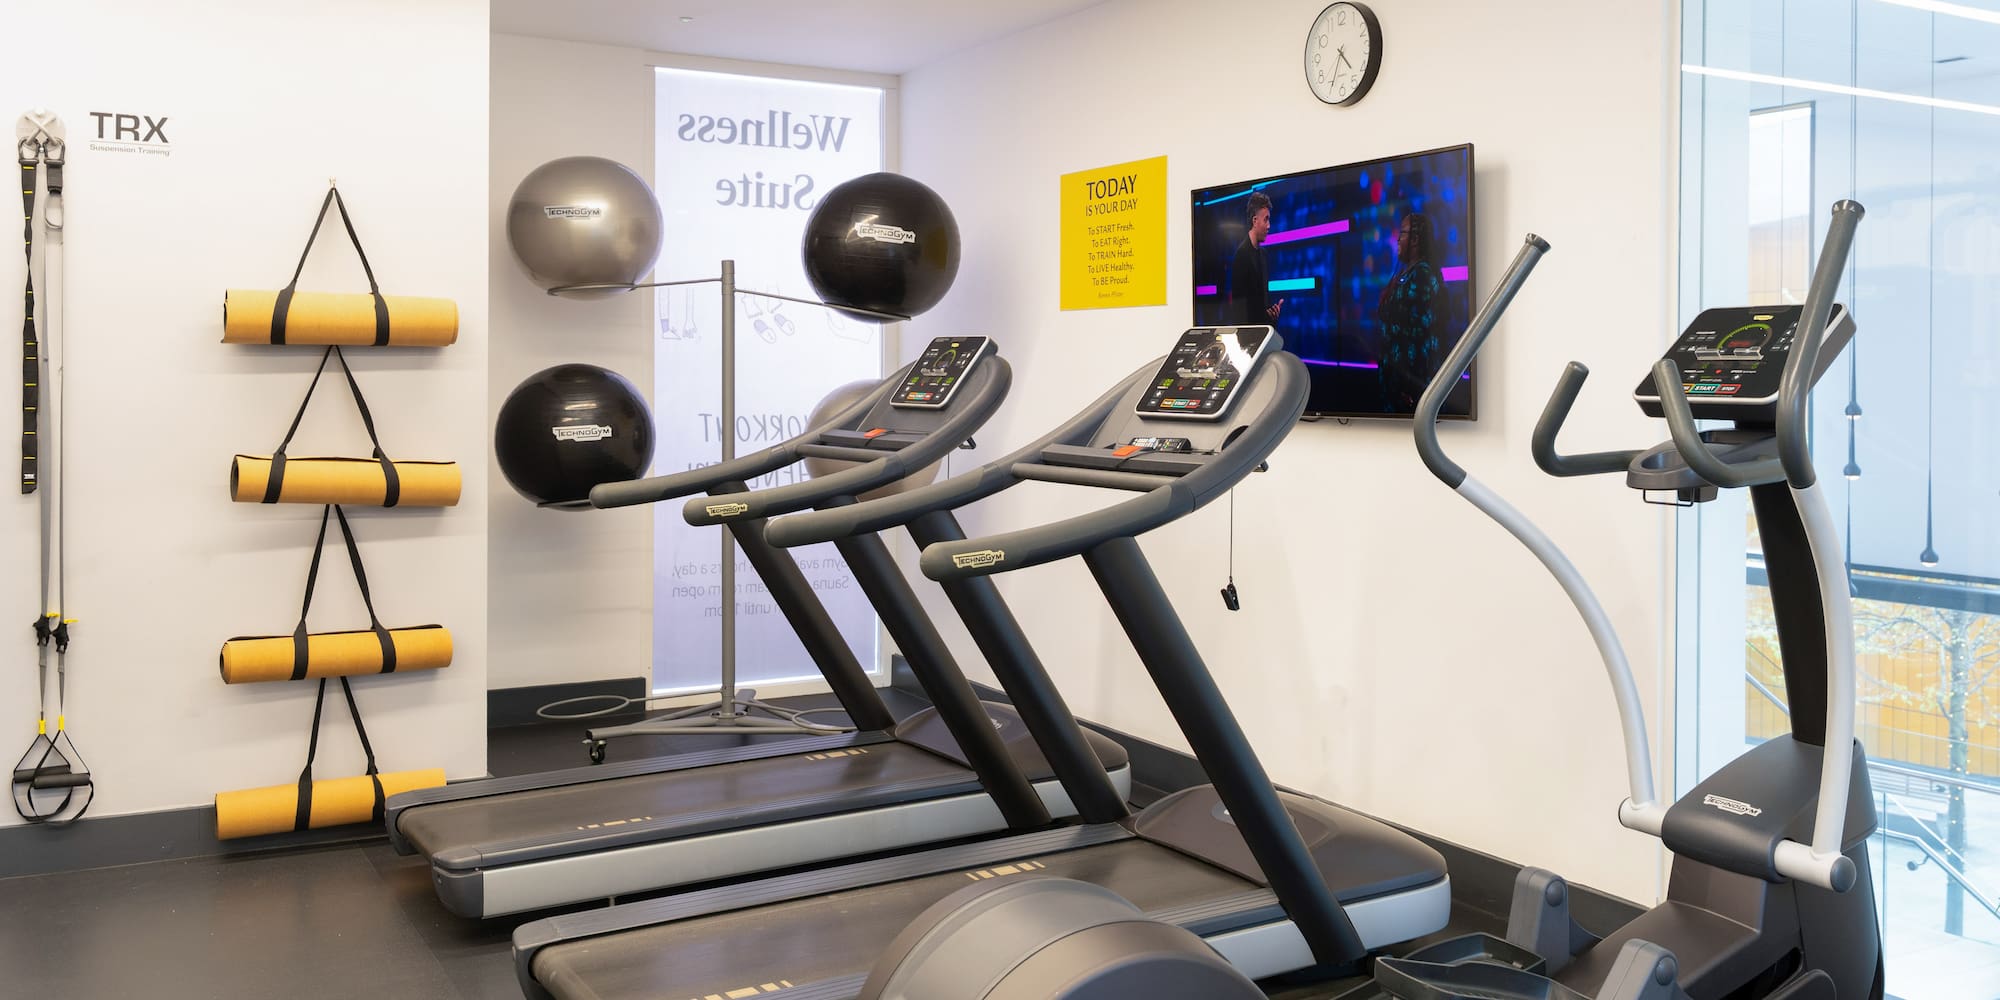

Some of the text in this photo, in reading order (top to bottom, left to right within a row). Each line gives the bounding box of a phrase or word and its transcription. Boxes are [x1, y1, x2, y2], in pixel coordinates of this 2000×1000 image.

[1360, 22, 1367, 37] 2
[1318, 69, 1324, 84] 8
[1351, 74, 1358, 89] 5
[1338, 82, 1346, 97] 6
[90, 112, 169, 143] TRX
[89, 143, 170, 156] Suspension Training
[1086, 174, 1137, 200] TODAY
[1086, 198, 1138, 216] IS YOUR DAY
[1088, 221, 1135, 236] To START Fresh.
[1092, 239, 1099, 248] To
[1100, 237, 1112, 247] EAT
[1088, 248, 1134, 261] To TRAIN Hard.
[1088, 265, 1095, 274] To
[1096, 263, 1109, 273] LIVE
[1092, 277, 1099, 286] To
[1100, 276, 1109, 286] BE
